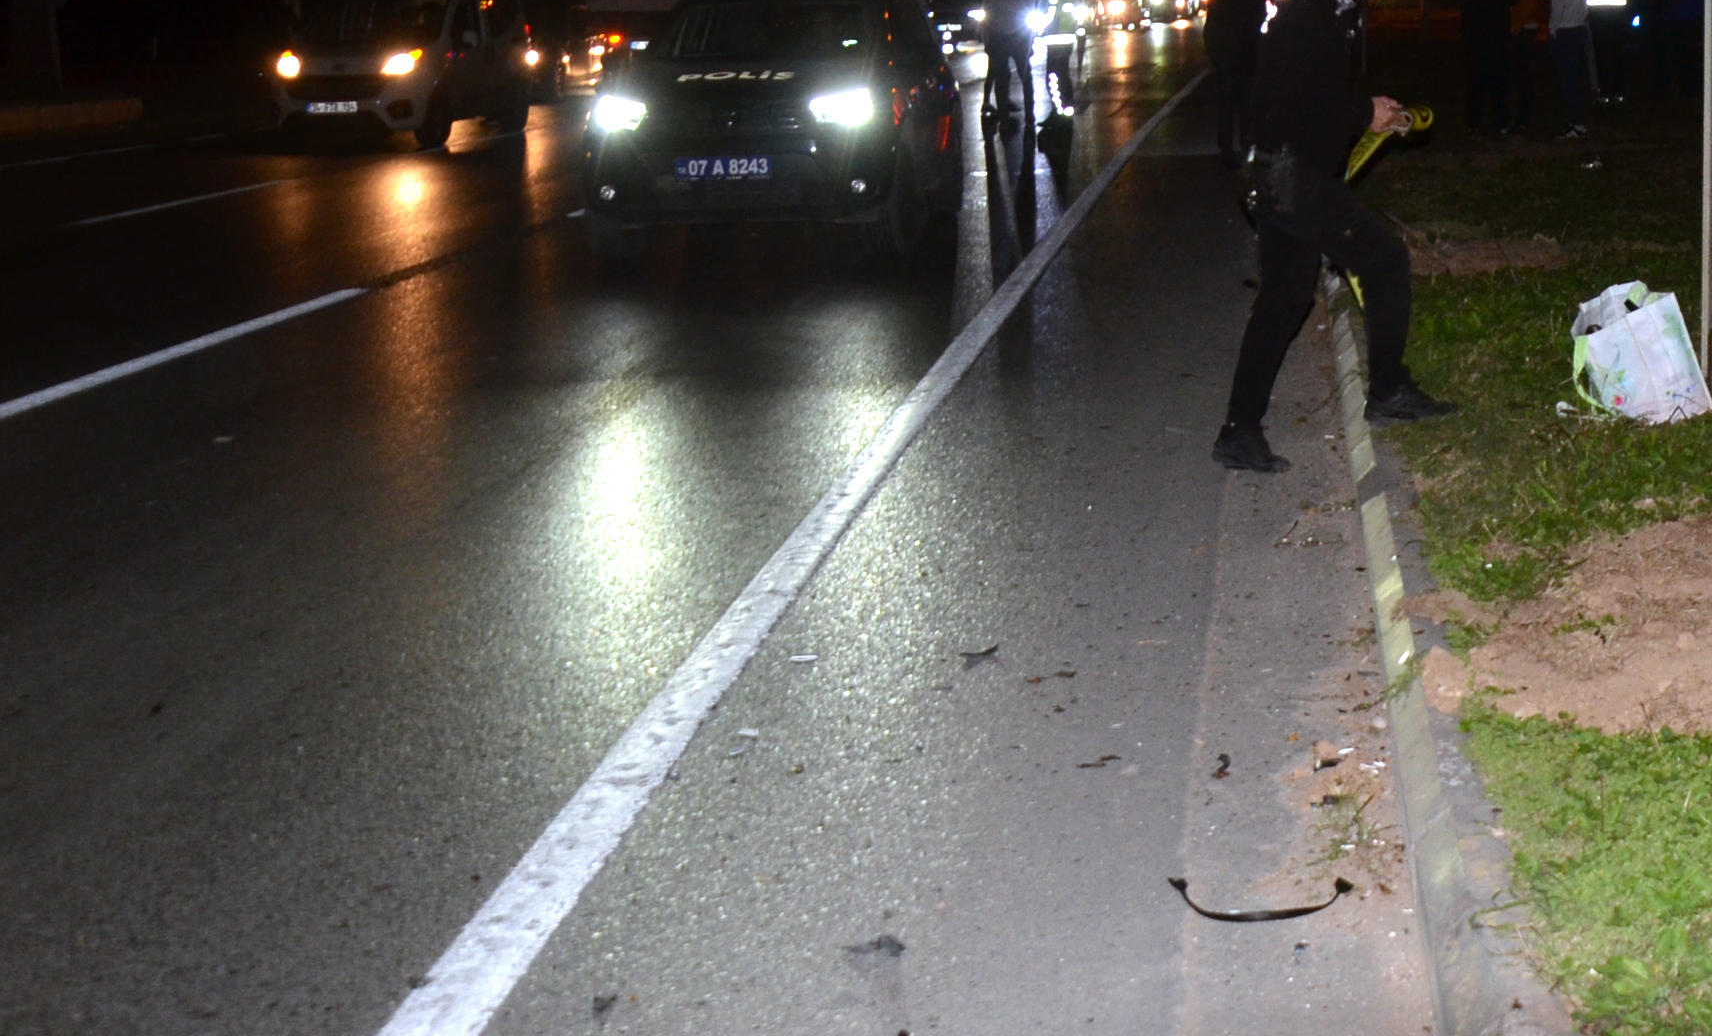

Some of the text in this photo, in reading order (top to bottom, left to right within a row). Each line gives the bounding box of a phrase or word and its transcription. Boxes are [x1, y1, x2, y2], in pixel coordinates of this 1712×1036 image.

[677, 70, 795, 82] POLİS
[688, 159, 708, 176] 07
[712, 159, 725, 175] A
[729, 158, 768, 175] 8243
